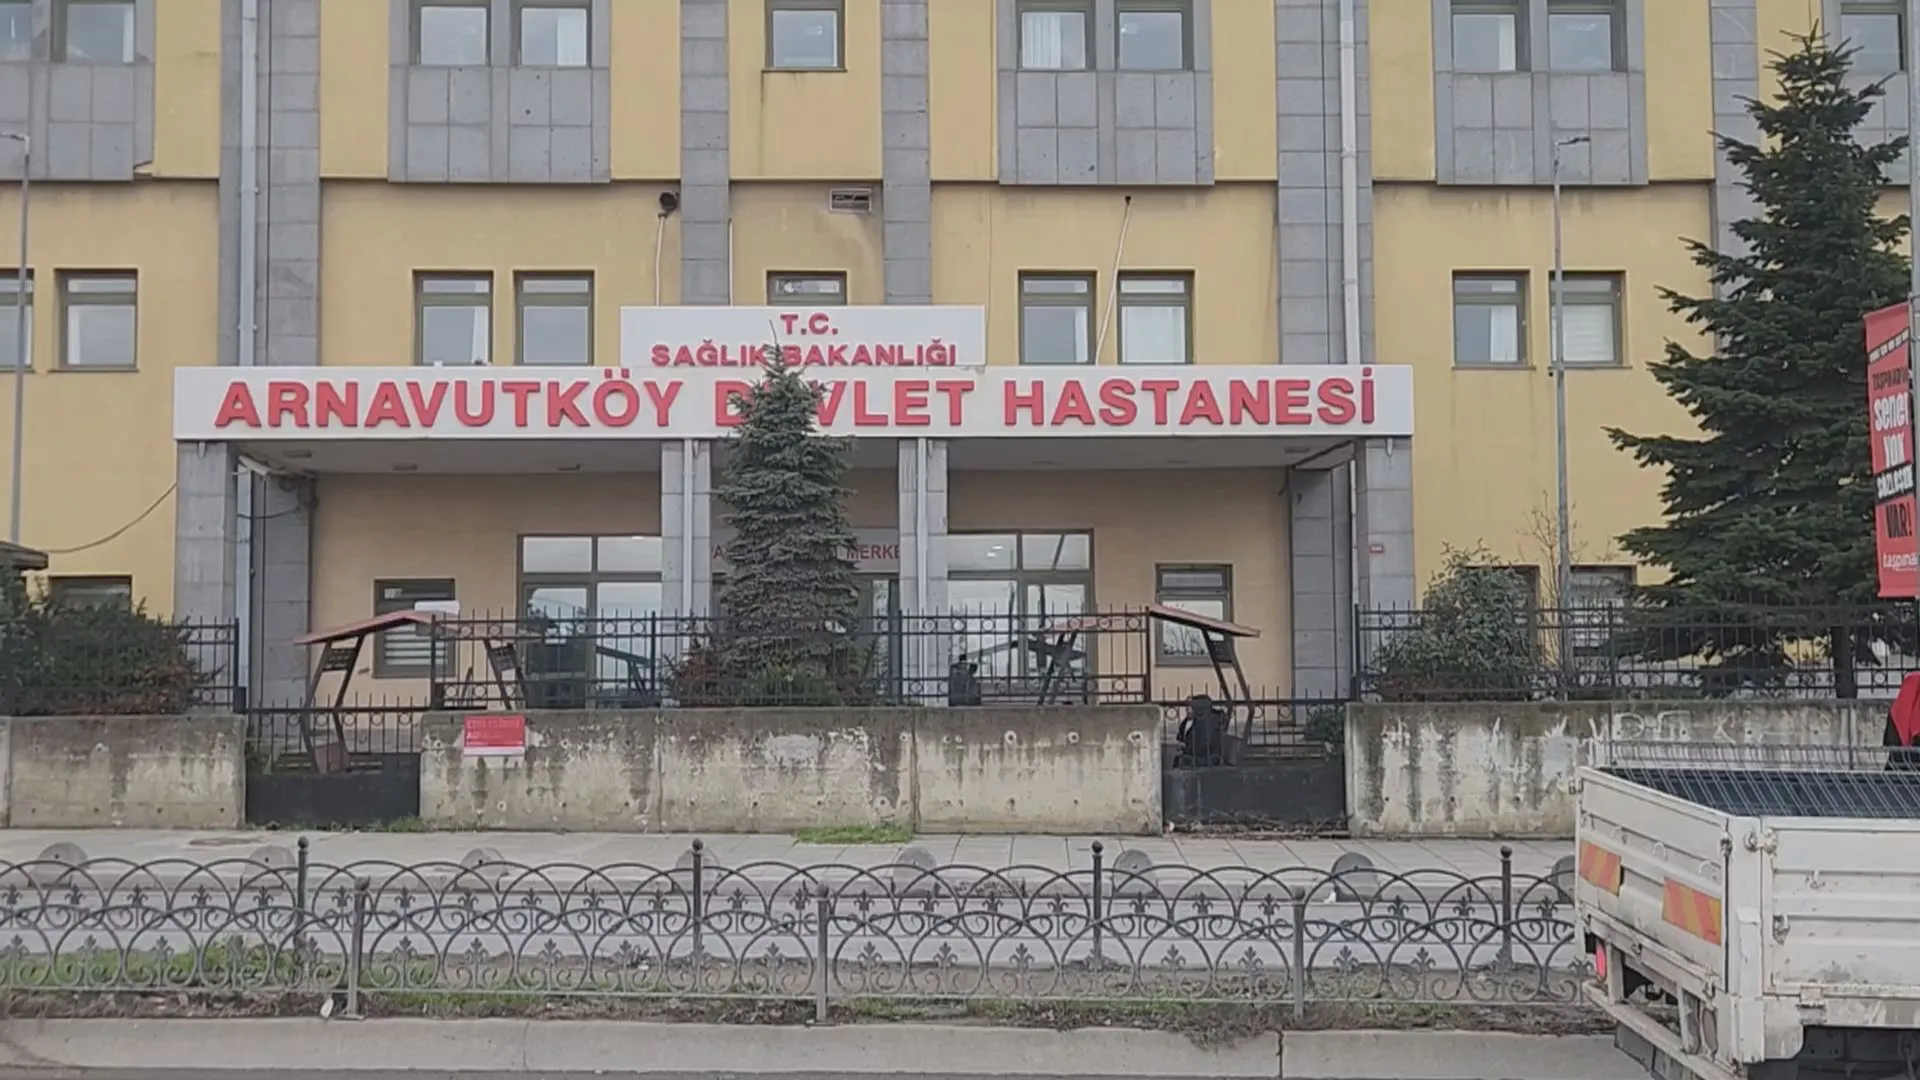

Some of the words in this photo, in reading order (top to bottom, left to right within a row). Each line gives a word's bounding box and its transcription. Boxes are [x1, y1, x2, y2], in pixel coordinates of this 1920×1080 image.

[780, 312, 838, 335] T.C.
[651, 339, 768, 366] SAĞLIK
[781, 339, 957, 366] BAKANLIĞI
[213, 368, 684, 429] ARNAVUTKÖY
[714, 379, 977, 427] DVLET
[1003, 367, 1376, 427] HASTANESİ
[1886, 501, 1912, 538] VAR!
